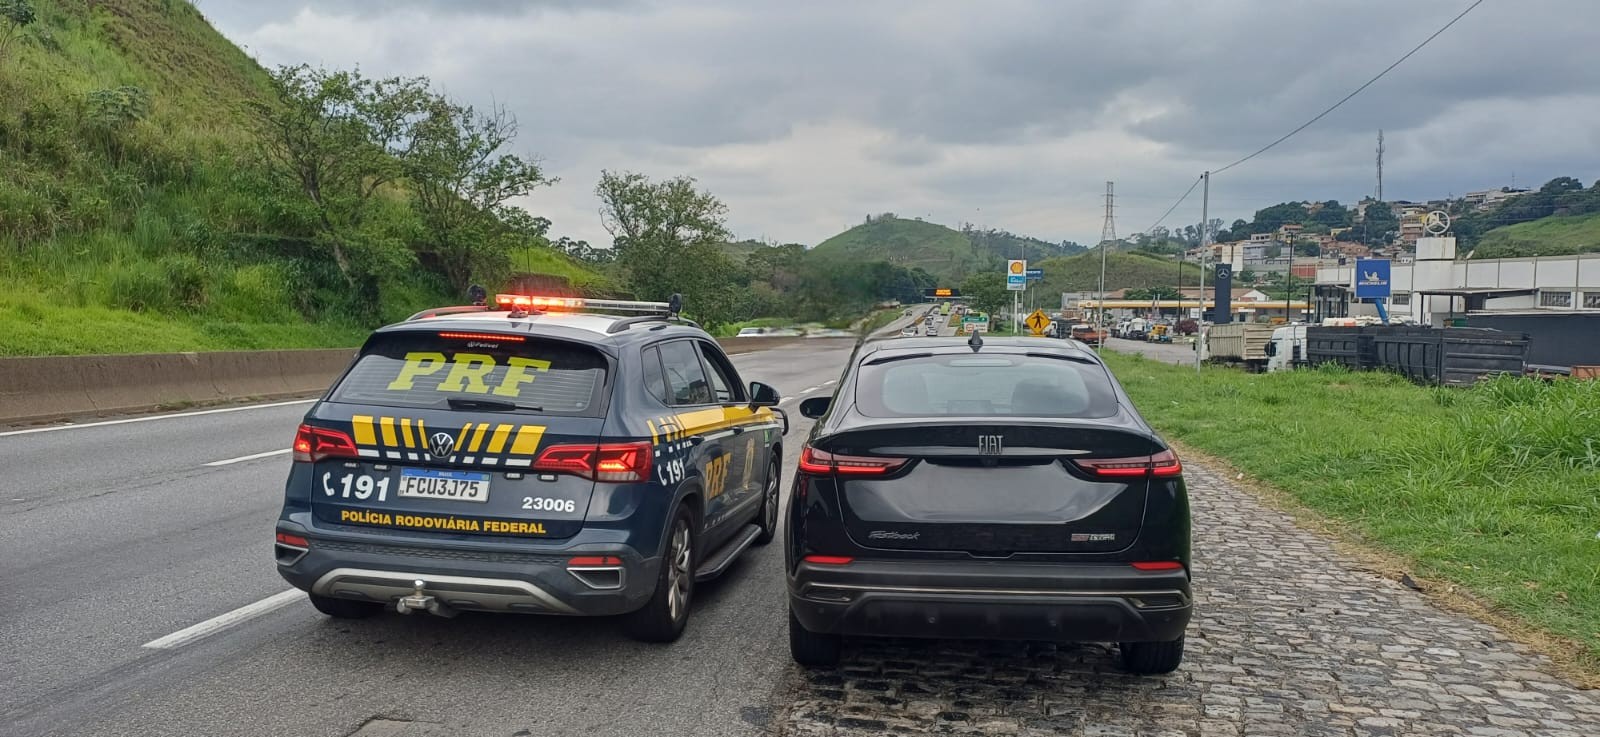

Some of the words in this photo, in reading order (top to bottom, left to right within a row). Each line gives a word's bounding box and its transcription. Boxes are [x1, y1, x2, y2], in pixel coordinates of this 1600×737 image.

[387, 351, 552, 398] PRF
[978, 435, 1004, 455] FIAT
[666, 459, 685, 484] 191
[705, 451, 732, 502] PRF
[340, 473, 391, 502] 191
[405, 476, 480, 498] FCU3J75
[521, 496, 576, 513] 23006
[341, 509, 393, 526] POLÍCIA
[395, 514, 480, 532] RODOVIÁRIA
[483, 520, 547, 534] FEDERAL
